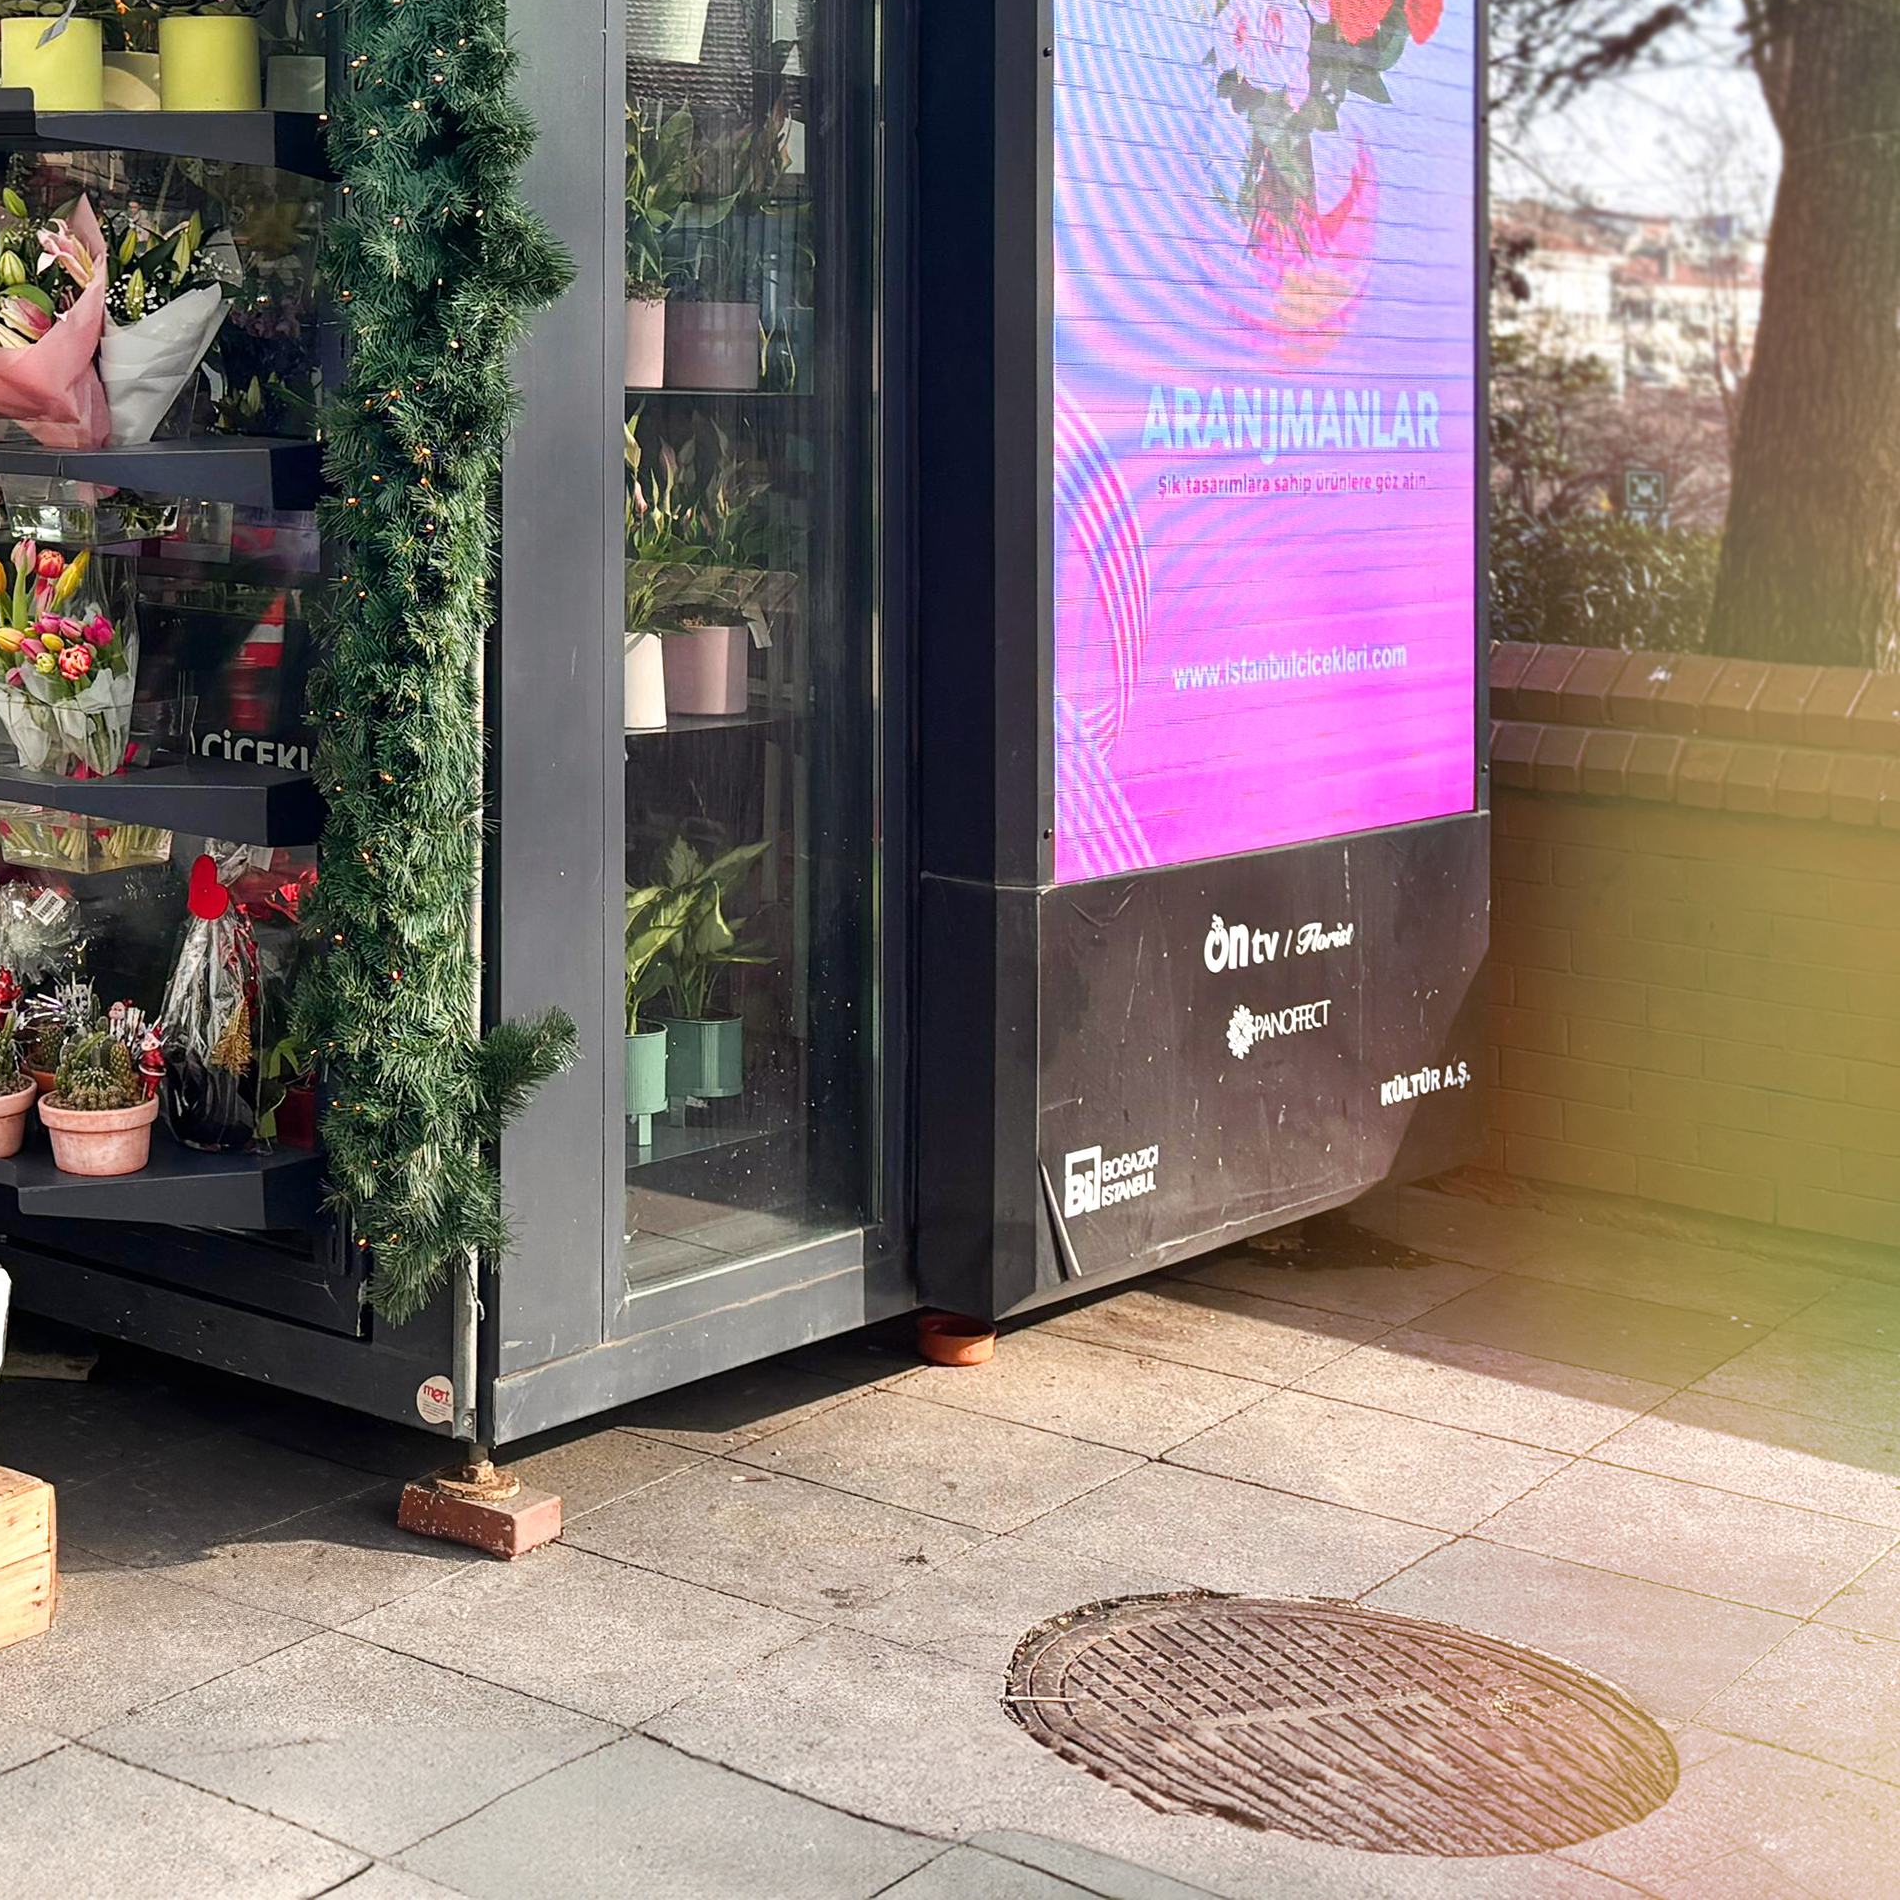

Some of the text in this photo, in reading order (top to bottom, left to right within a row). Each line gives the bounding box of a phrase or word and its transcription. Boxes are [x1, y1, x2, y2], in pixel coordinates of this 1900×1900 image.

[1141, 385, 1440, 466] ARANJMANLAR
[1186, 473, 1270, 495] tasarımlara
[1274, 473, 1312, 495] sahip
[1316, 472, 1372, 492] ürünlere
[1376, 471, 1398, 494] göz
[1172, 644, 1407, 690] www.istanbulcicekleri.com
[1296, 922, 1355, 955] Florist
[1254, 1000, 1332, 1041] PANOFFECT
[1381, 1061, 1471, 1107] KÜLTÜR A.Ş.
